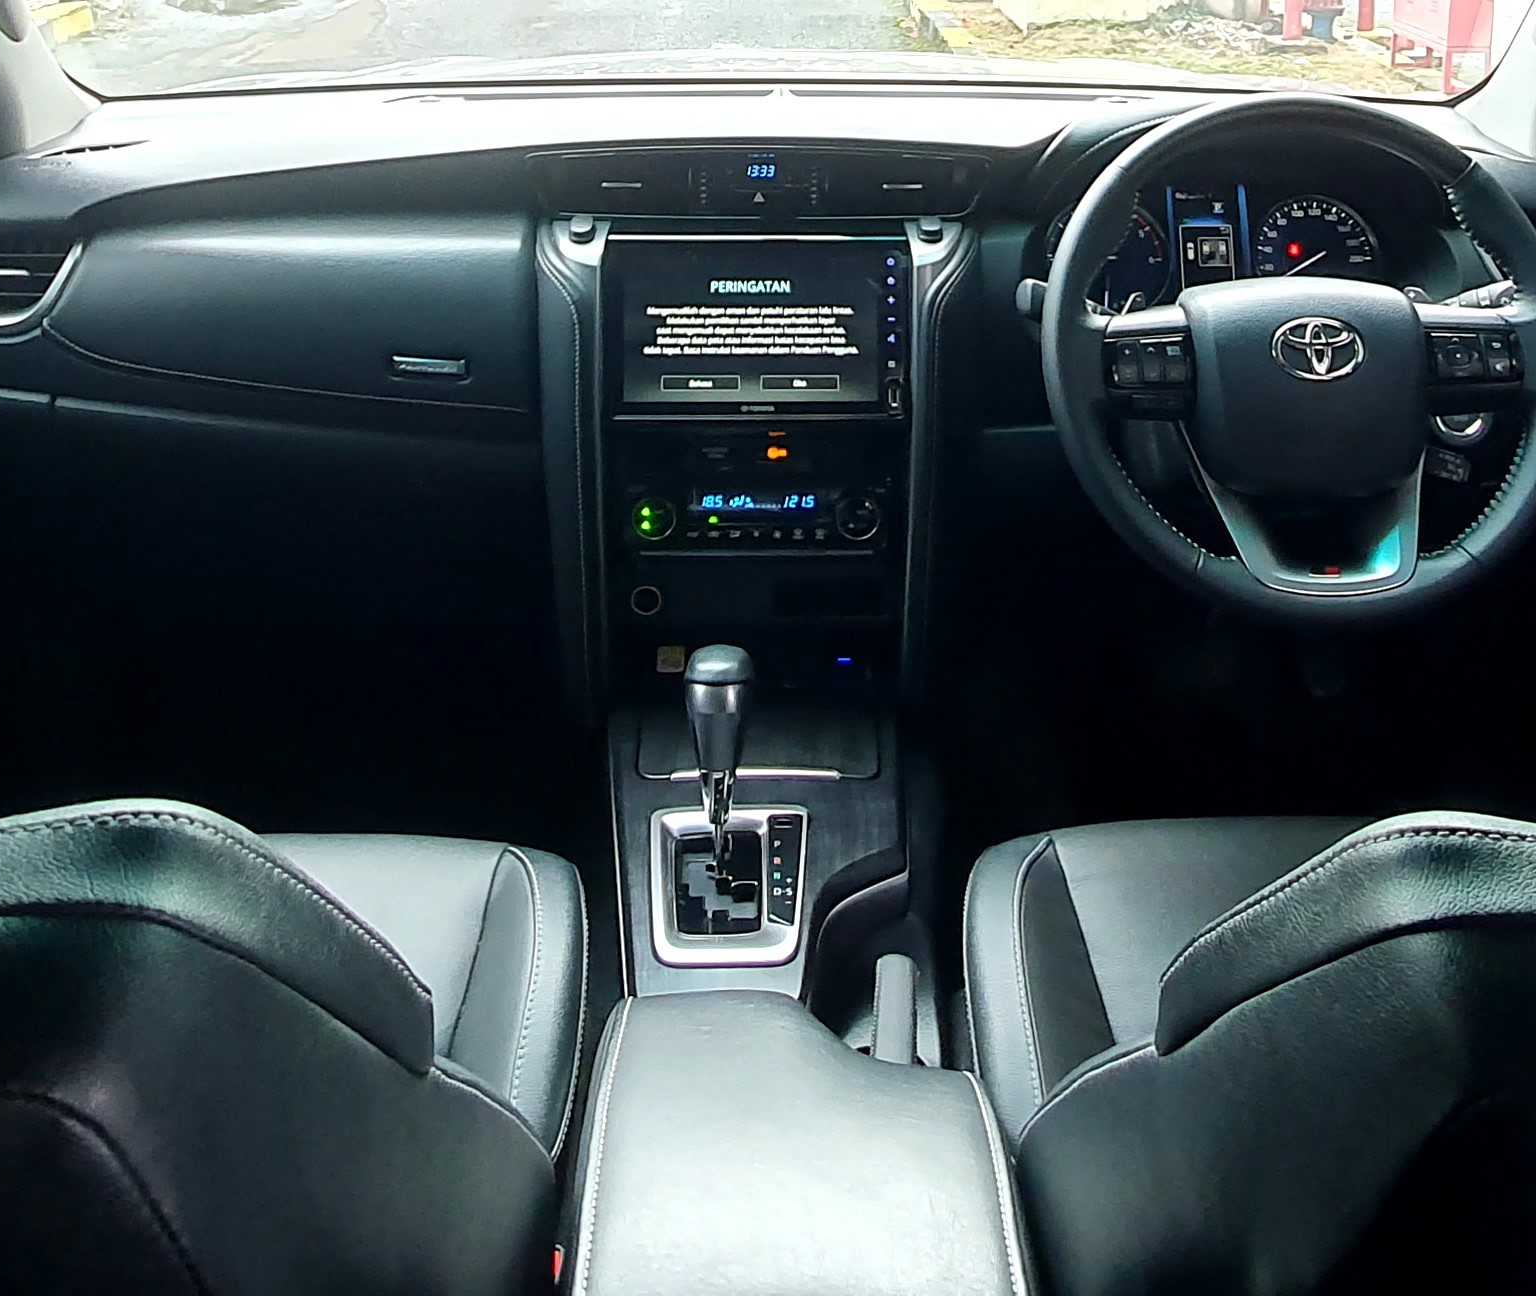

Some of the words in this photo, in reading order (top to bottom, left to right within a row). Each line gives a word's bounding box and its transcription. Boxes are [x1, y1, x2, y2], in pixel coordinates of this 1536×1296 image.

[747, 165, 775, 177] 13:33
[710, 280, 791, 294] PERINGATAN
[773, 840, 781, 848] P
